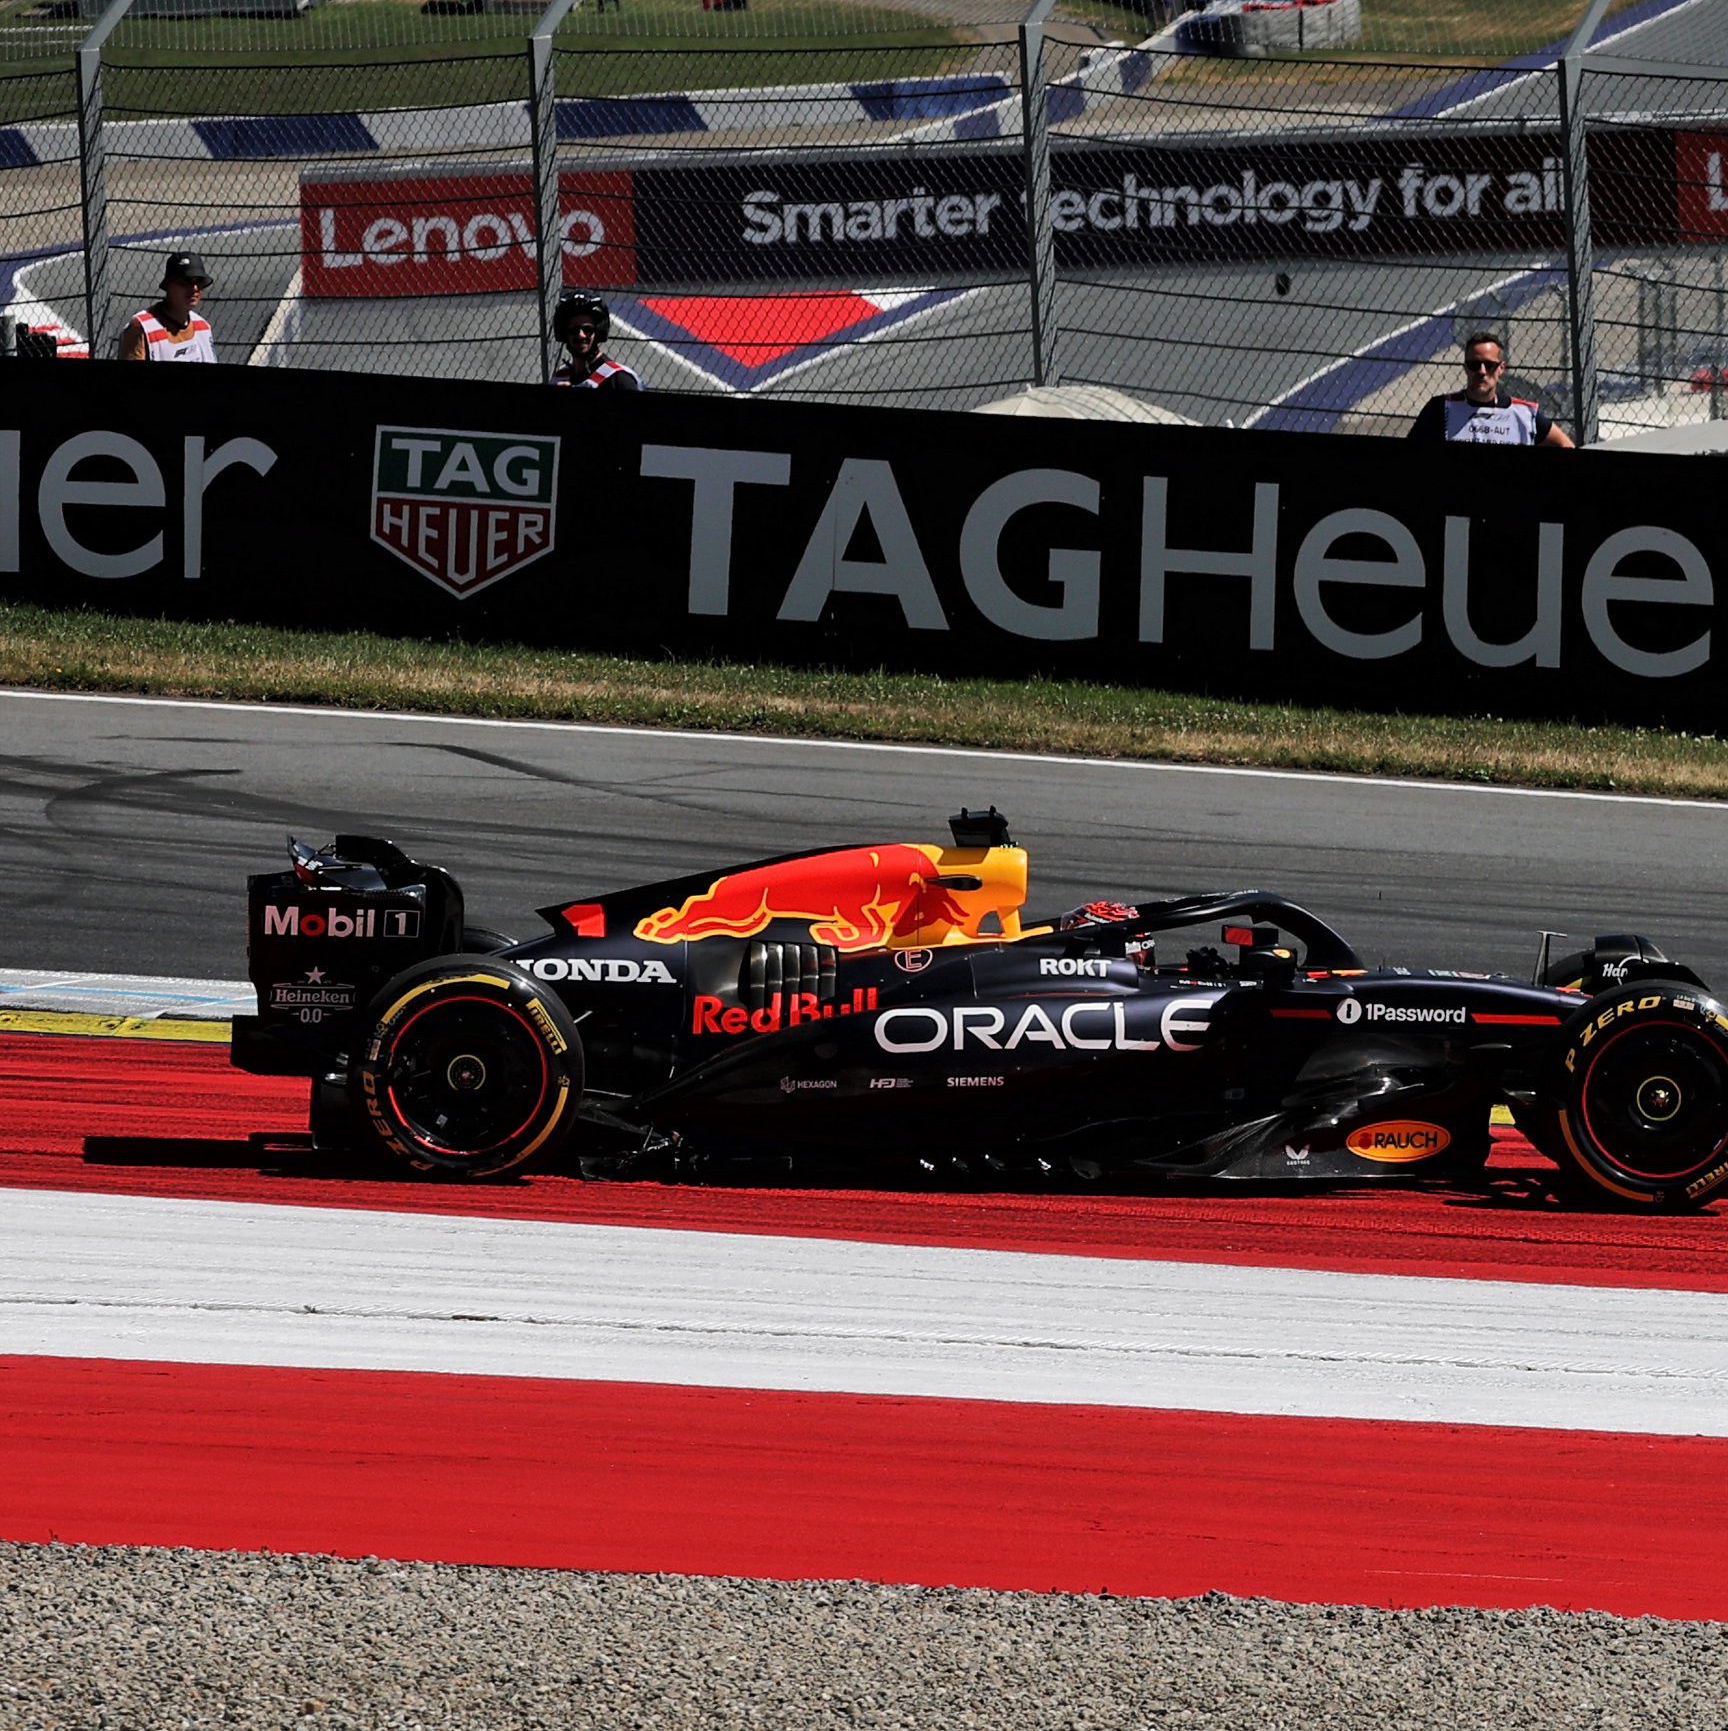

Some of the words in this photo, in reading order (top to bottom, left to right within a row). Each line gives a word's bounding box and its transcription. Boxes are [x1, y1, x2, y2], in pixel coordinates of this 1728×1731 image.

[741, 187, 999, 246] Smarter
[1020, 168, 1382, 233] echnology
[1400, 162, 1491, 218] for
[390, 437, 541, 497] TAG
[0, 427, 278, 579] er
[379, 502, 546, 585] HEUER
[263, 905, 375, 938] Mobil
[1039, 956, 1112, 979] ROKT
[1602, 963, 1628, 978] Har
[275, 987, 350, 1006] Heineken
[1364, 1002, 1467, 1023] 1Password
[299, 1008, 323, 1024] 0.0
[525, 997, 568, 1055] PIRELLI
[692, 993, 782, 1035] Red
[873, 999, 1216, 1052] ORACLE
[1579, 995, 1662, 1047] ZERO
[797, 1079, 838, 1089] HEXAGON
[946, 1075, 1006, 1088] SIEMENS
[1373, 1131, 1438, 1150] RAUCH
